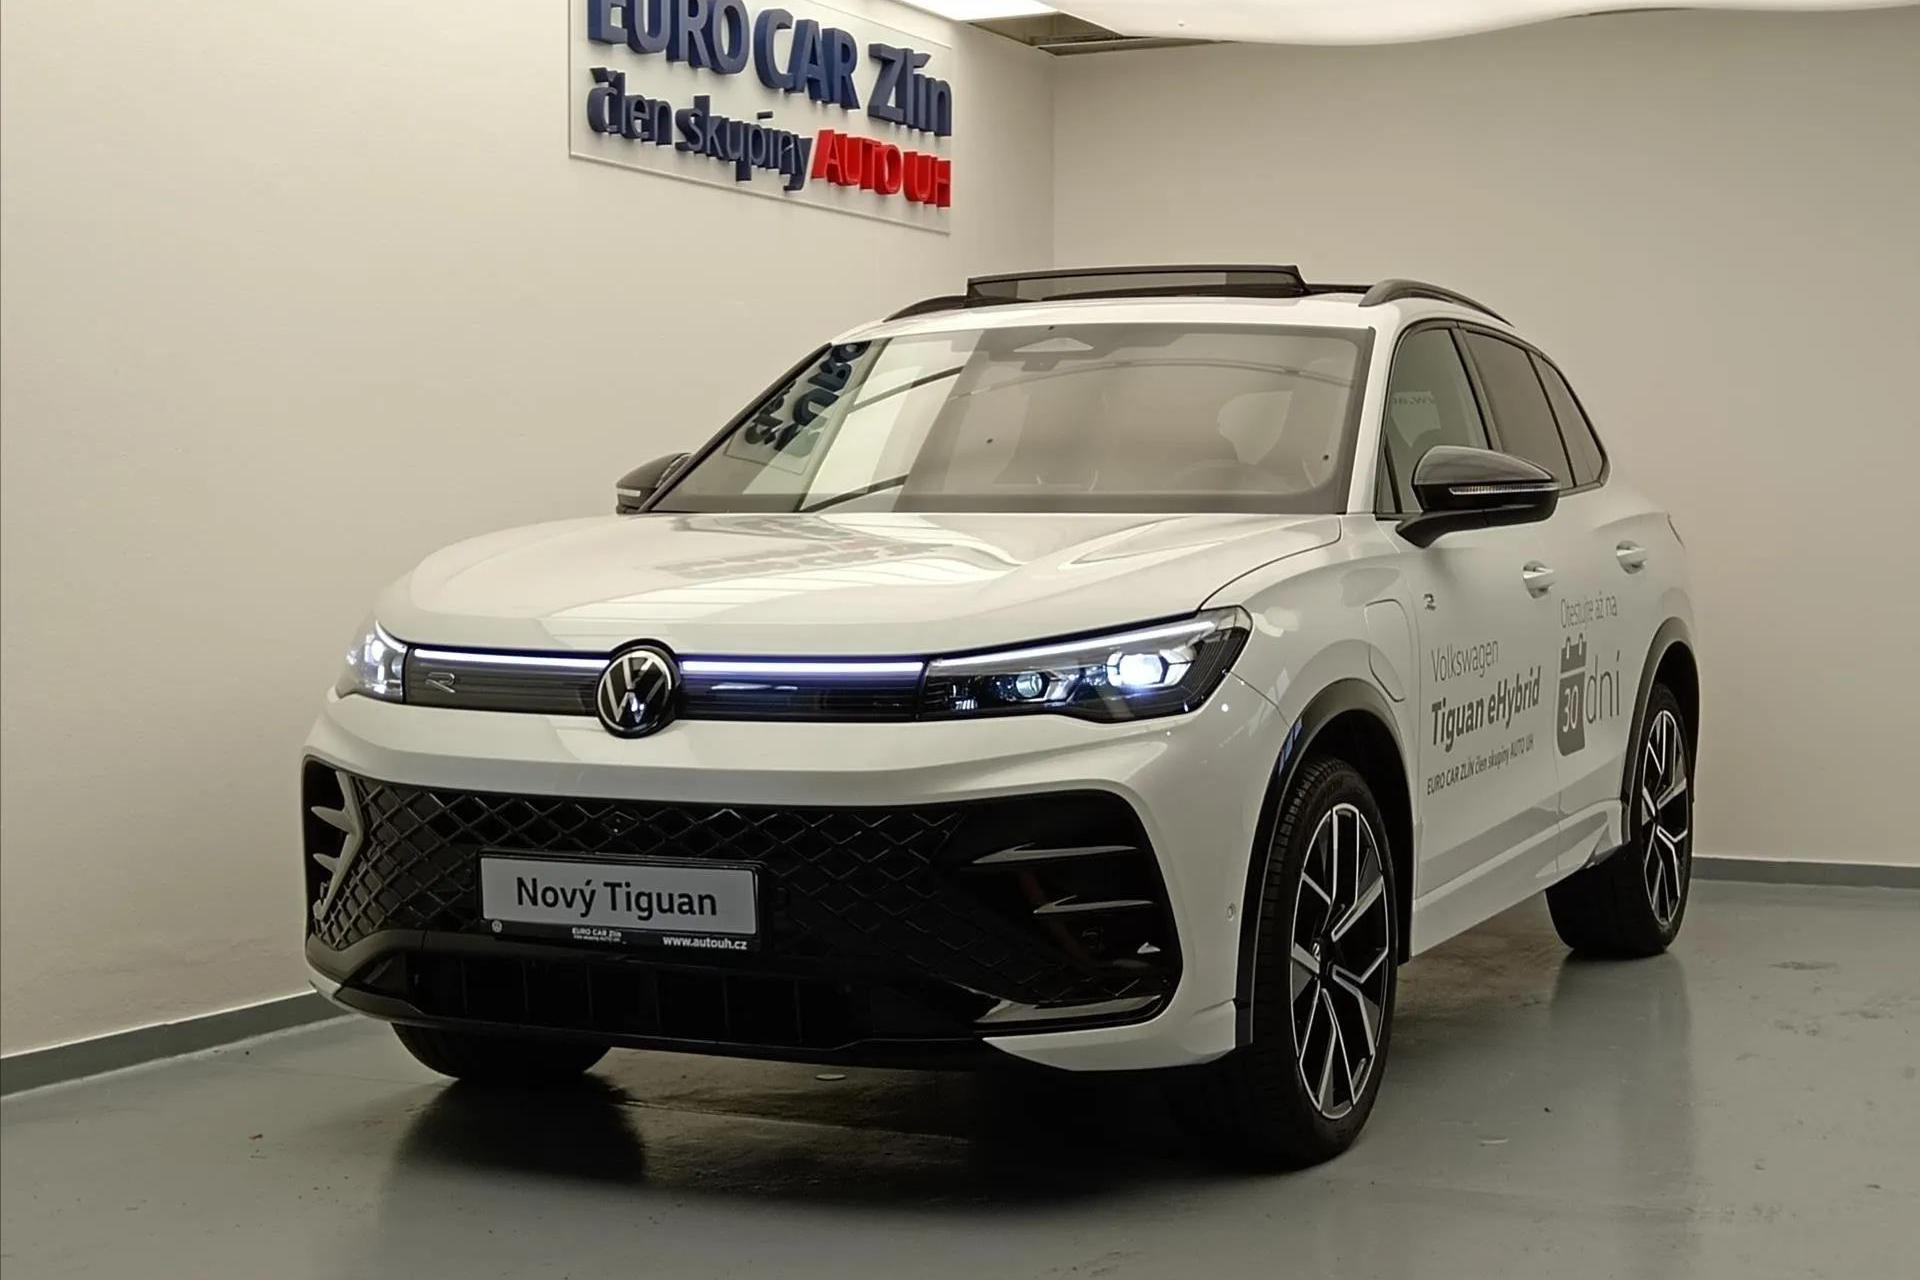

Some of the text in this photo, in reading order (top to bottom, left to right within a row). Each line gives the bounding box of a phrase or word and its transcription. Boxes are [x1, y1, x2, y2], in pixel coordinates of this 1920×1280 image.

[587, 0, 952, 137] EURO CAR Zlín
[586, 67, 952, 208] člen skupiny AUTO UH
[1431, 640, 1499, 683] Volkswagen
[1563, 649, 1620, 733] 30 dní
[1431, 665, 1542, 752] Tiguan eHybrid
[515, 877, 718, 921] Nový Tiguan
[662, 936, 748, 950] www.autouh.cz
